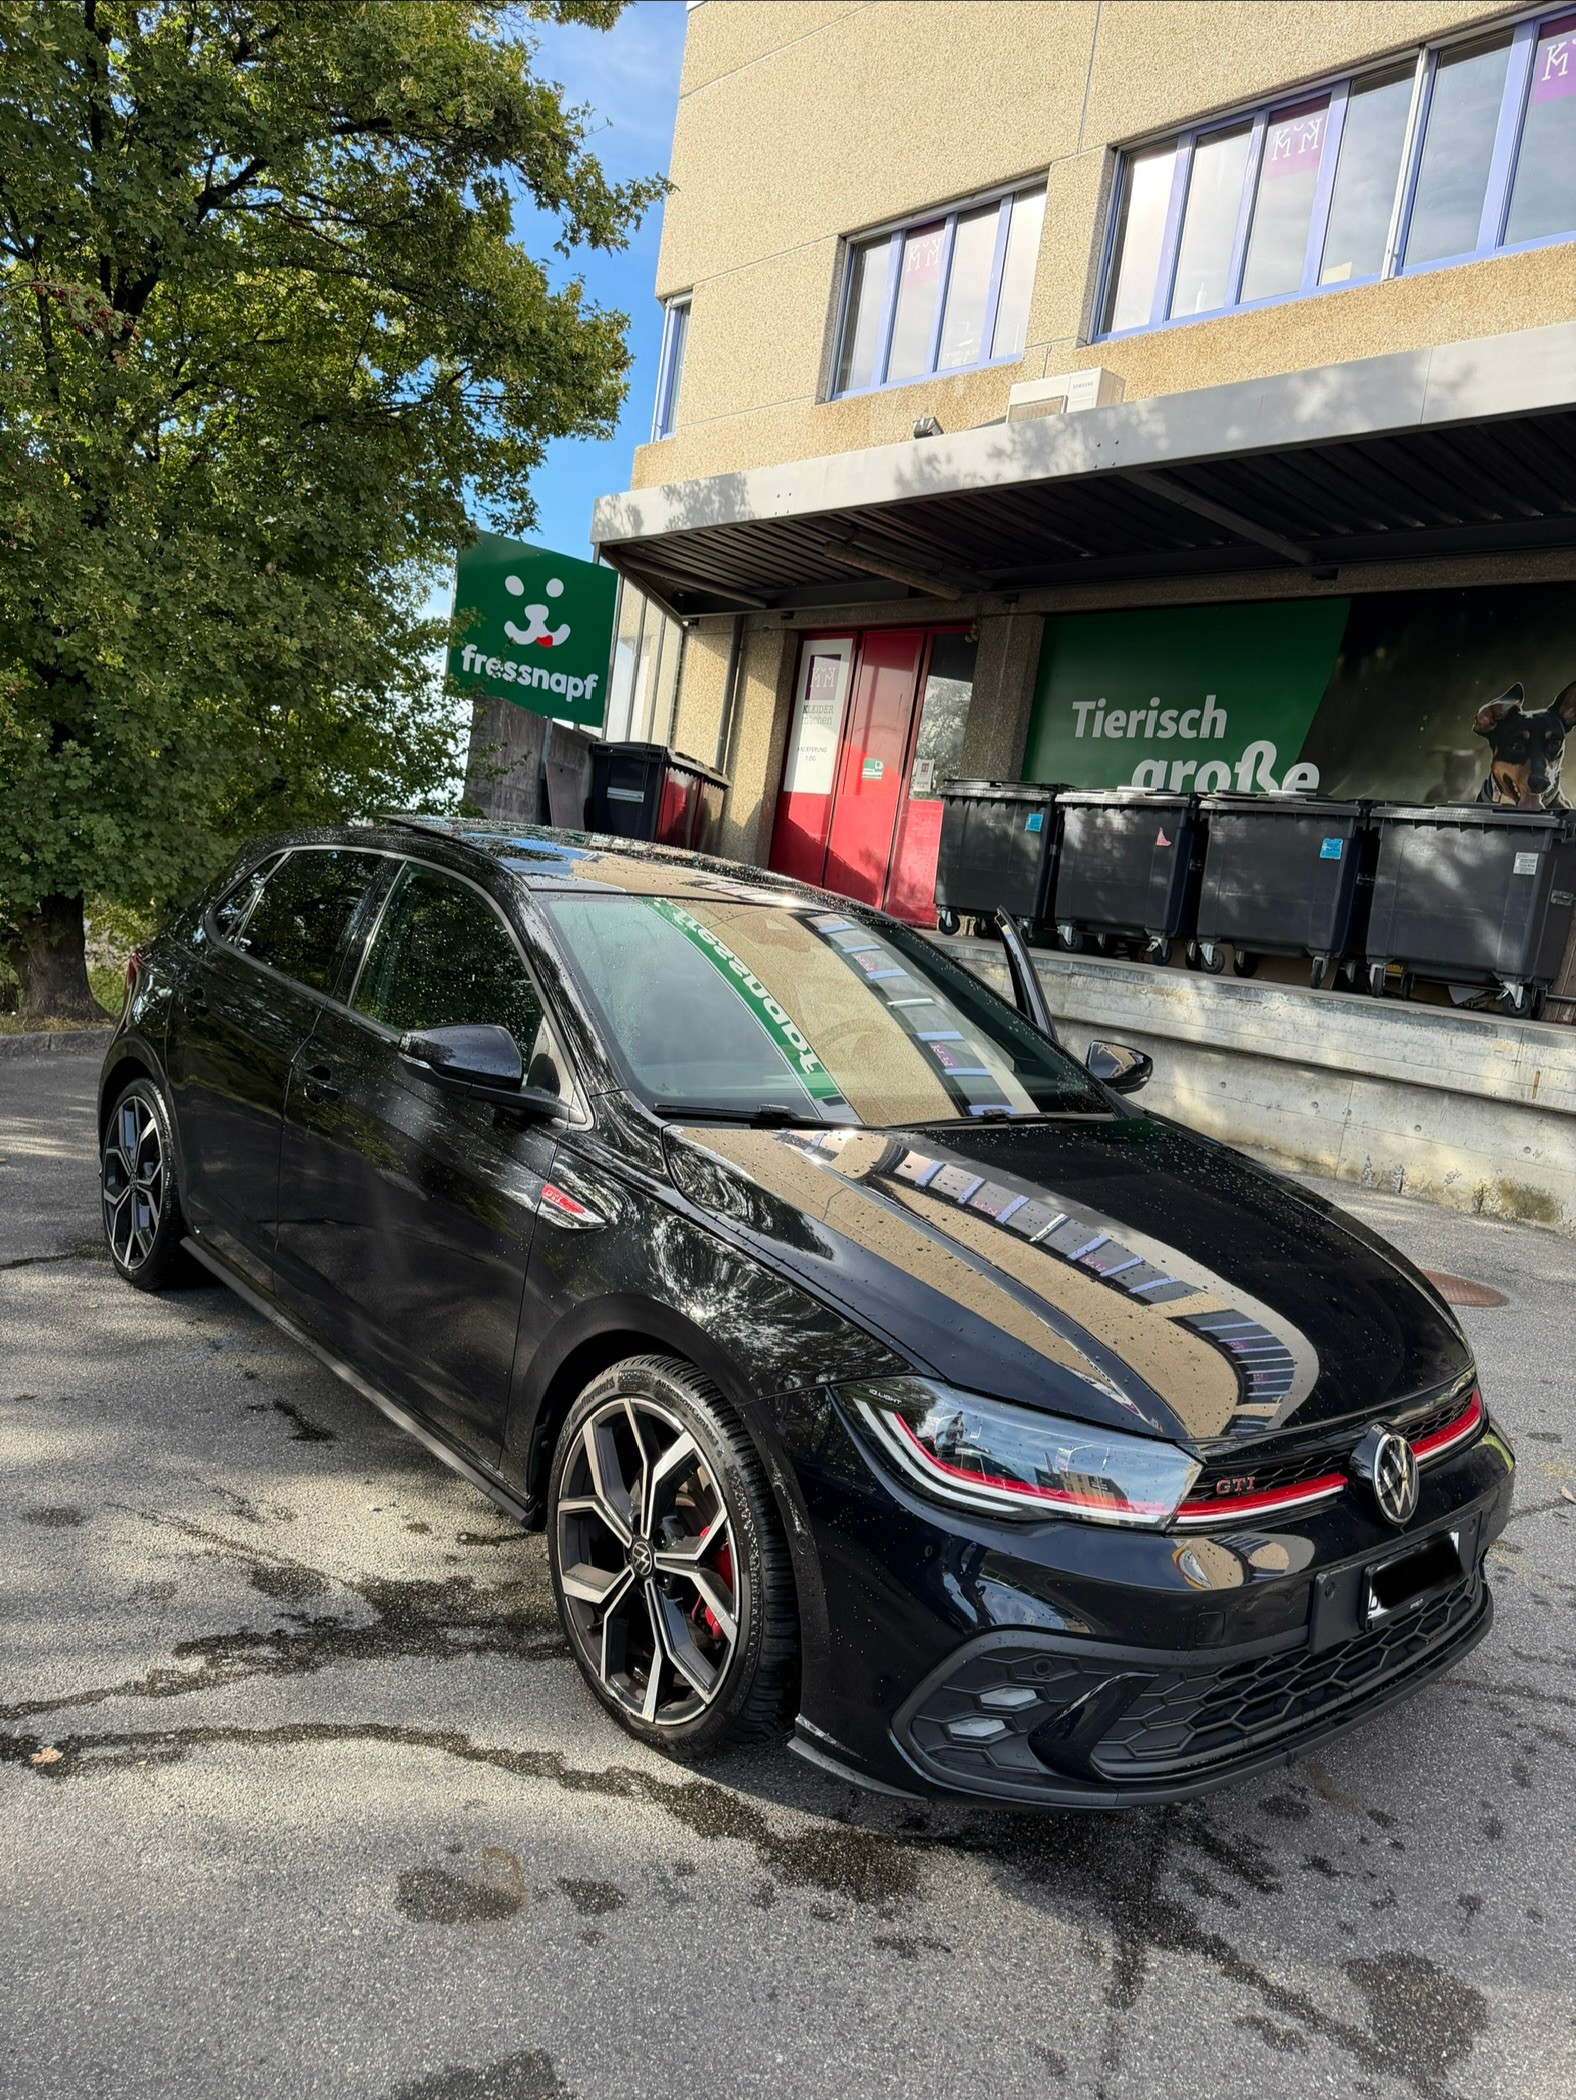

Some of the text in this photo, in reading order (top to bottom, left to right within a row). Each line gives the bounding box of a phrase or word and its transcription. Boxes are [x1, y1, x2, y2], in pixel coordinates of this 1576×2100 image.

[461, 644, 599, 702] fressnapf
[1071, 693, 1228, 739] Tierisch
[1131, 739, 1321, 793] große
[1216, 1476, 1256, 1496] GTI
